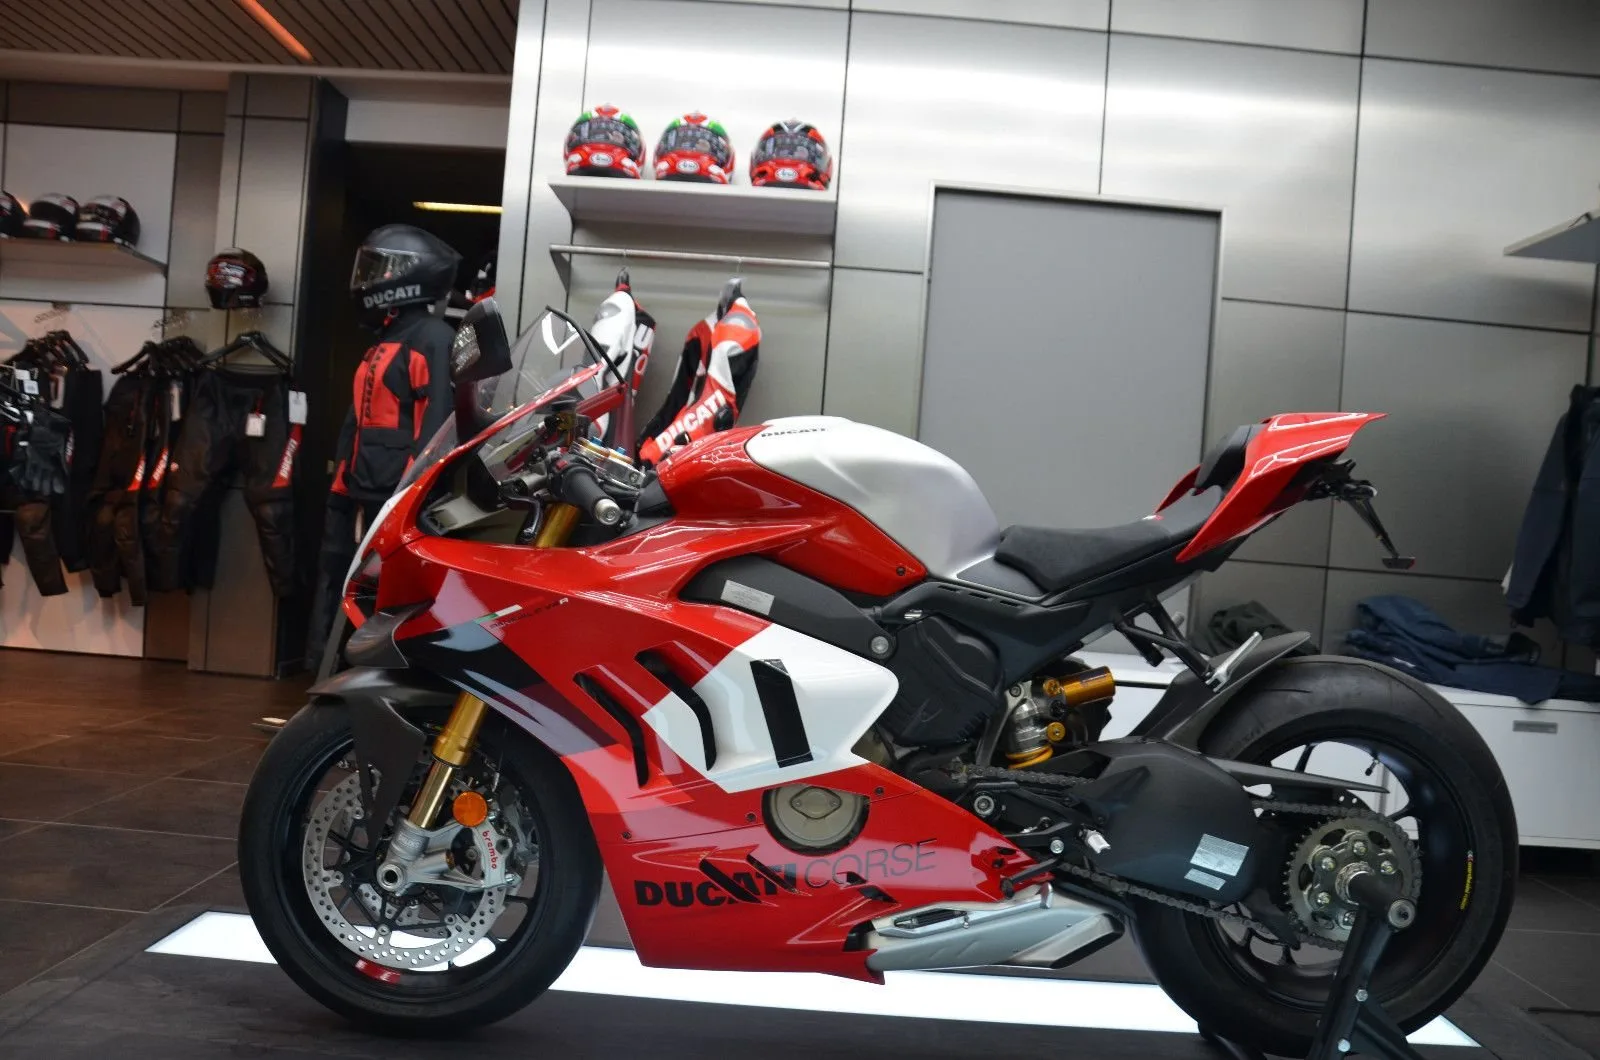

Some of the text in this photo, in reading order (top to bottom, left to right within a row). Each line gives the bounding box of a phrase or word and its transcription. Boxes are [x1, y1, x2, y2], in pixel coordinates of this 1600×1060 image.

[363, 284, 421, 308] DUCATI
[761, 427, 826, 437] DUCATI
[482, 830, 499, 870] brembo
[804, 838, 938, 888] CORSE
